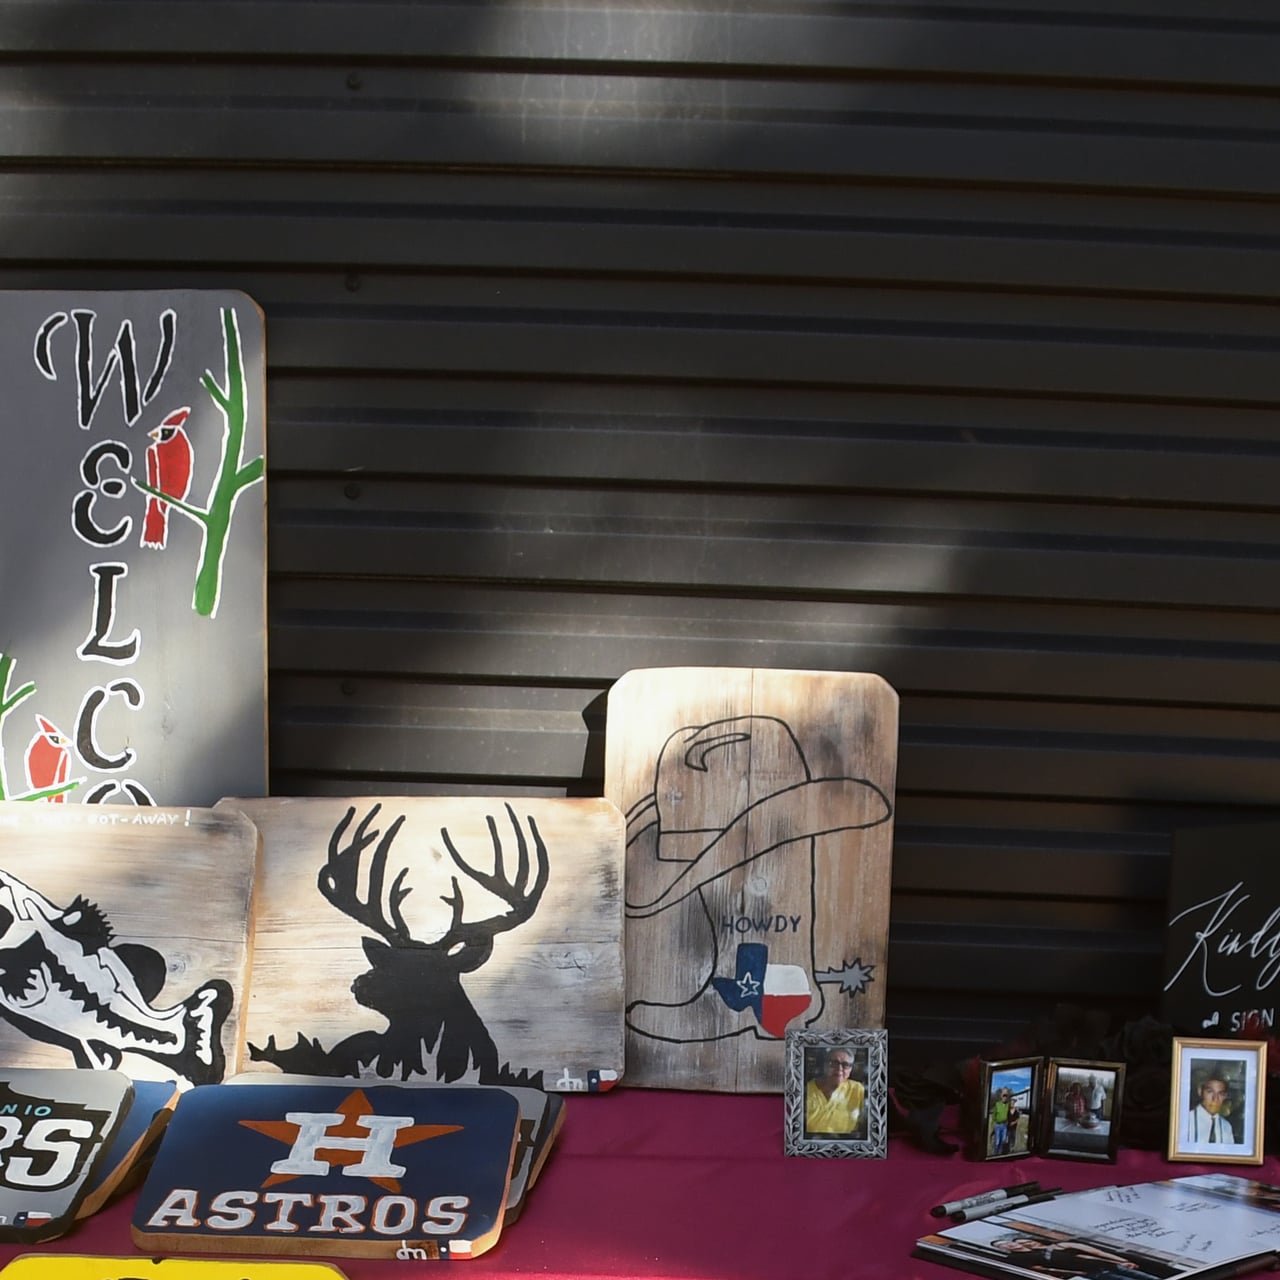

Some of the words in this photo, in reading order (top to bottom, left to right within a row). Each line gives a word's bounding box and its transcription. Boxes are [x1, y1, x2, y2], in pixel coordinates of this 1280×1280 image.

[34, 309, 176, 807] WELC
[721, 914, 802, 935] HOWDY
[271, 1112, 415, 1178] H
[146, 1188, 470, 1236] ASTROS
